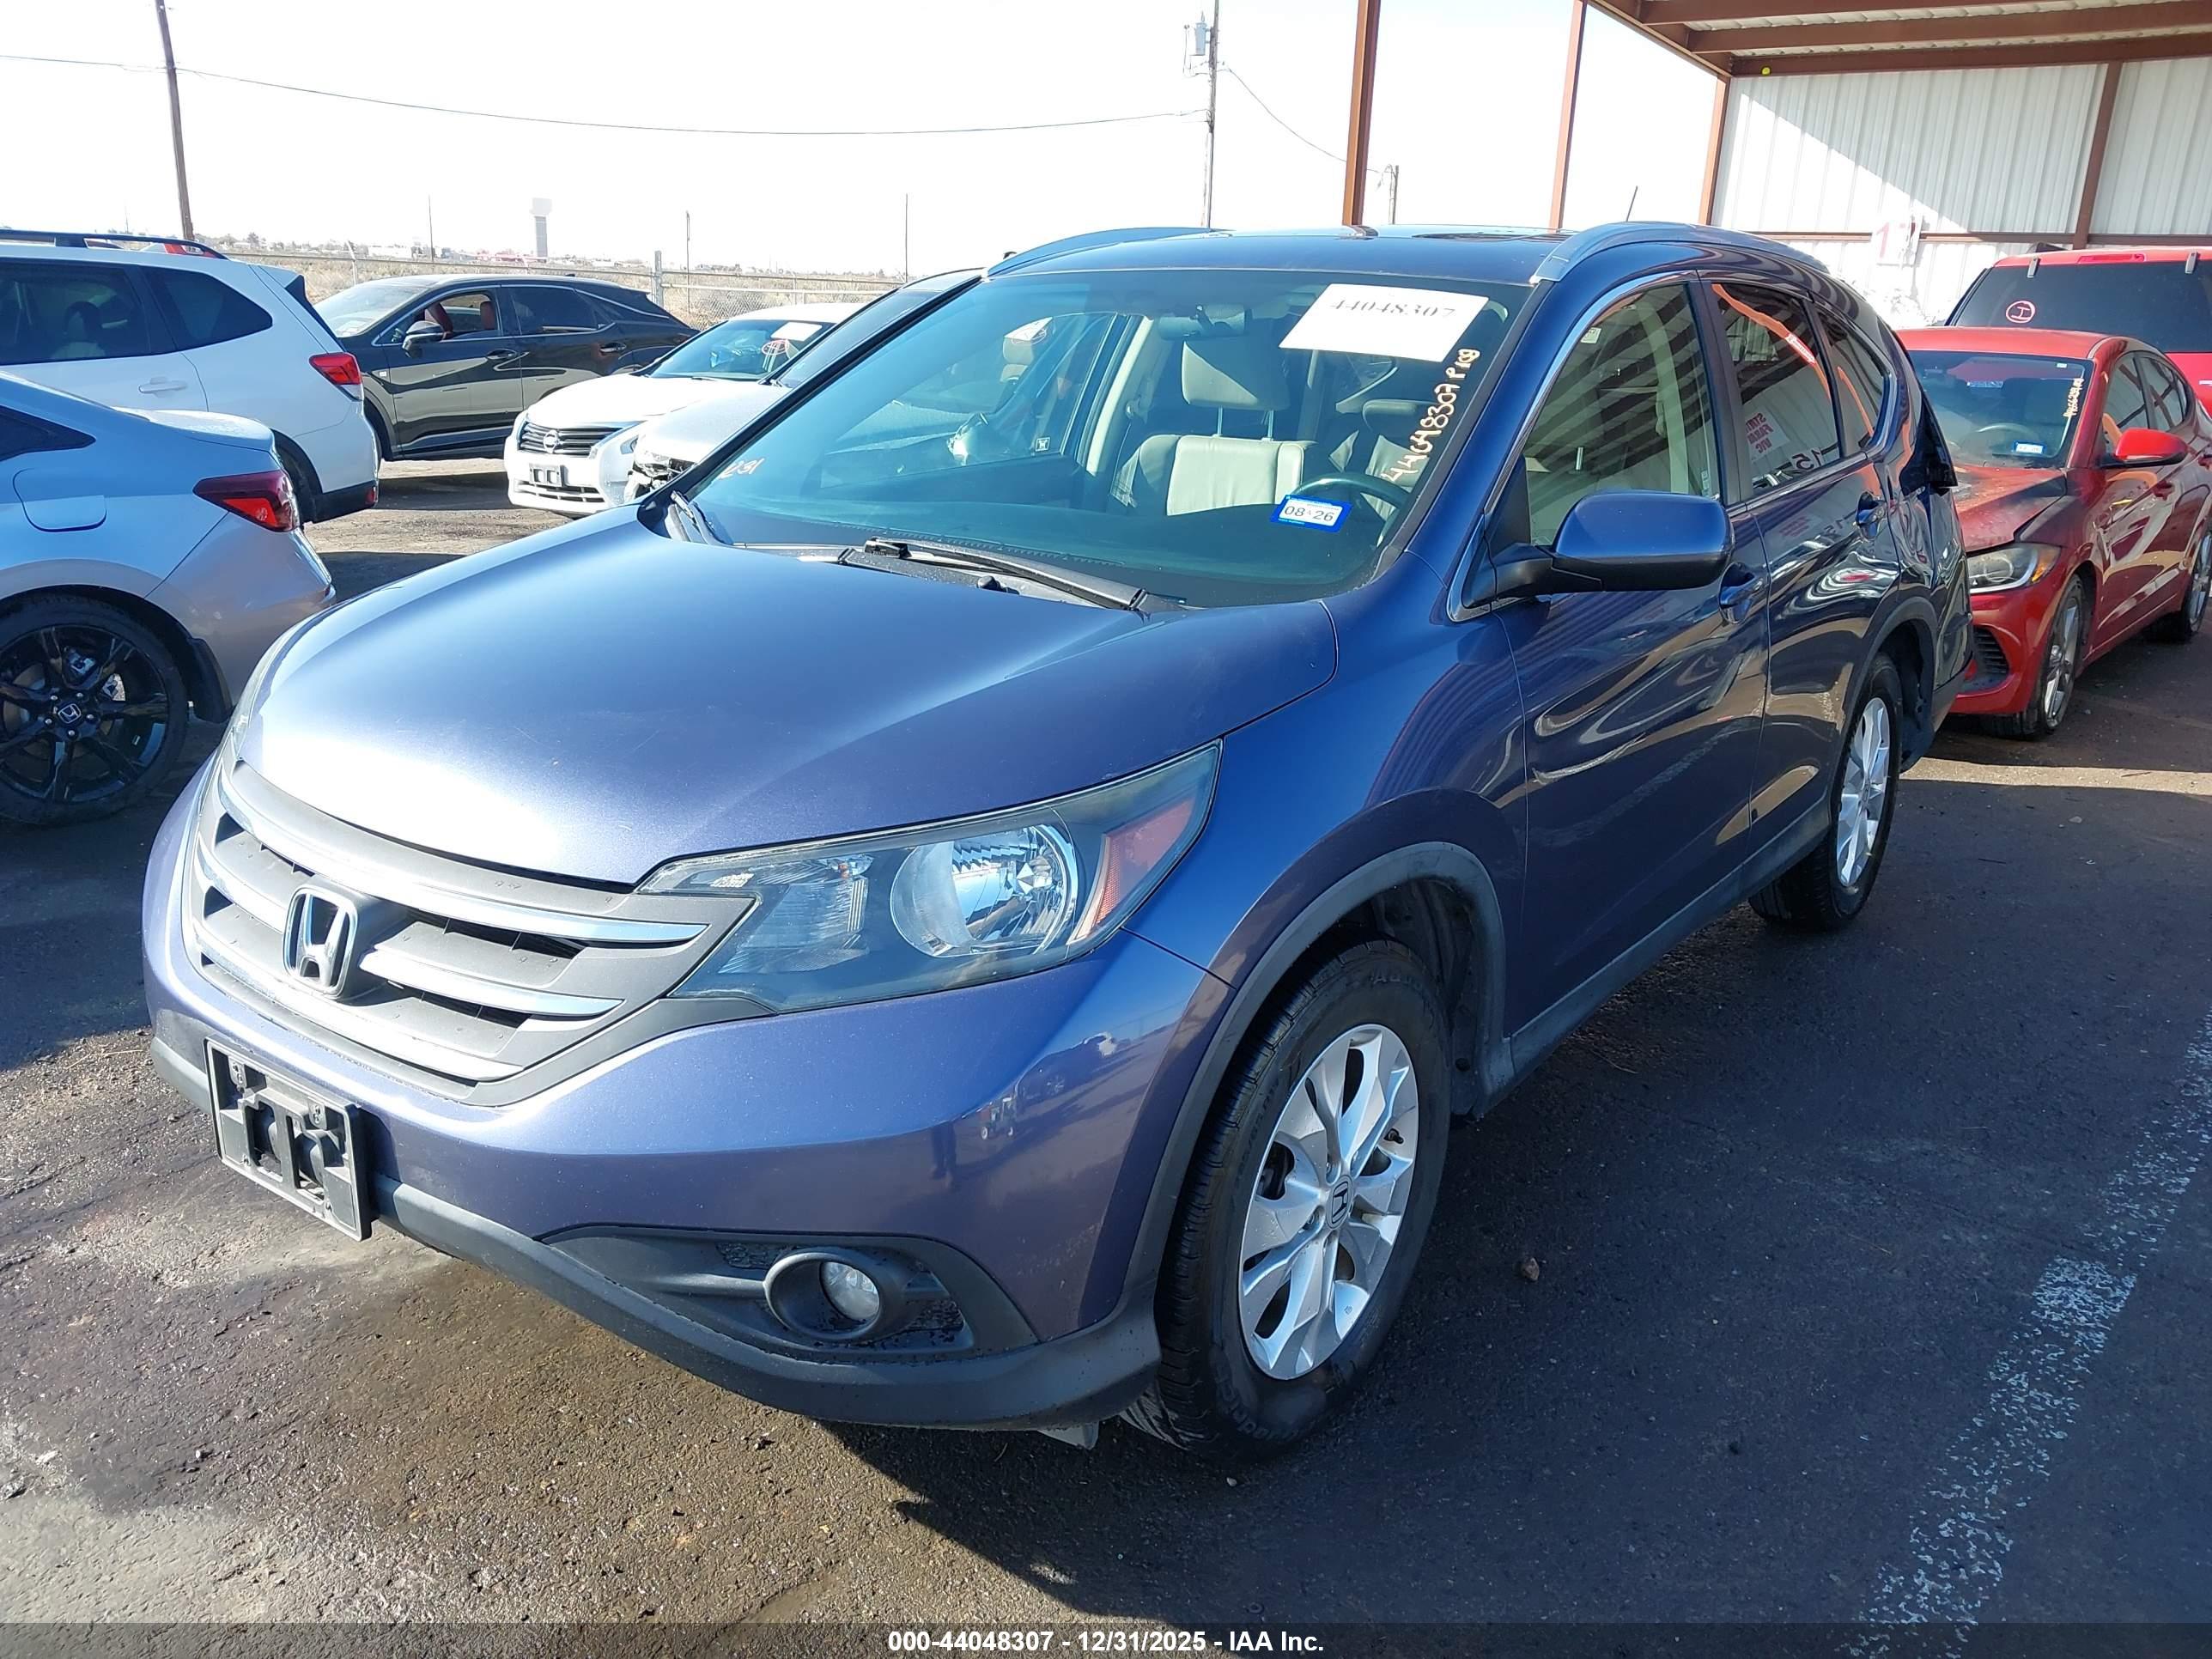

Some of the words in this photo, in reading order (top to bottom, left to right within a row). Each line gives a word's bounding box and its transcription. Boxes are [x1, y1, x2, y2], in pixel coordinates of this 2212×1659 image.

[1329, 299, 1456, 318] 44048307
[1284, 505, 1306, 517] 08
[1312, 510, 1334, 522] 26
